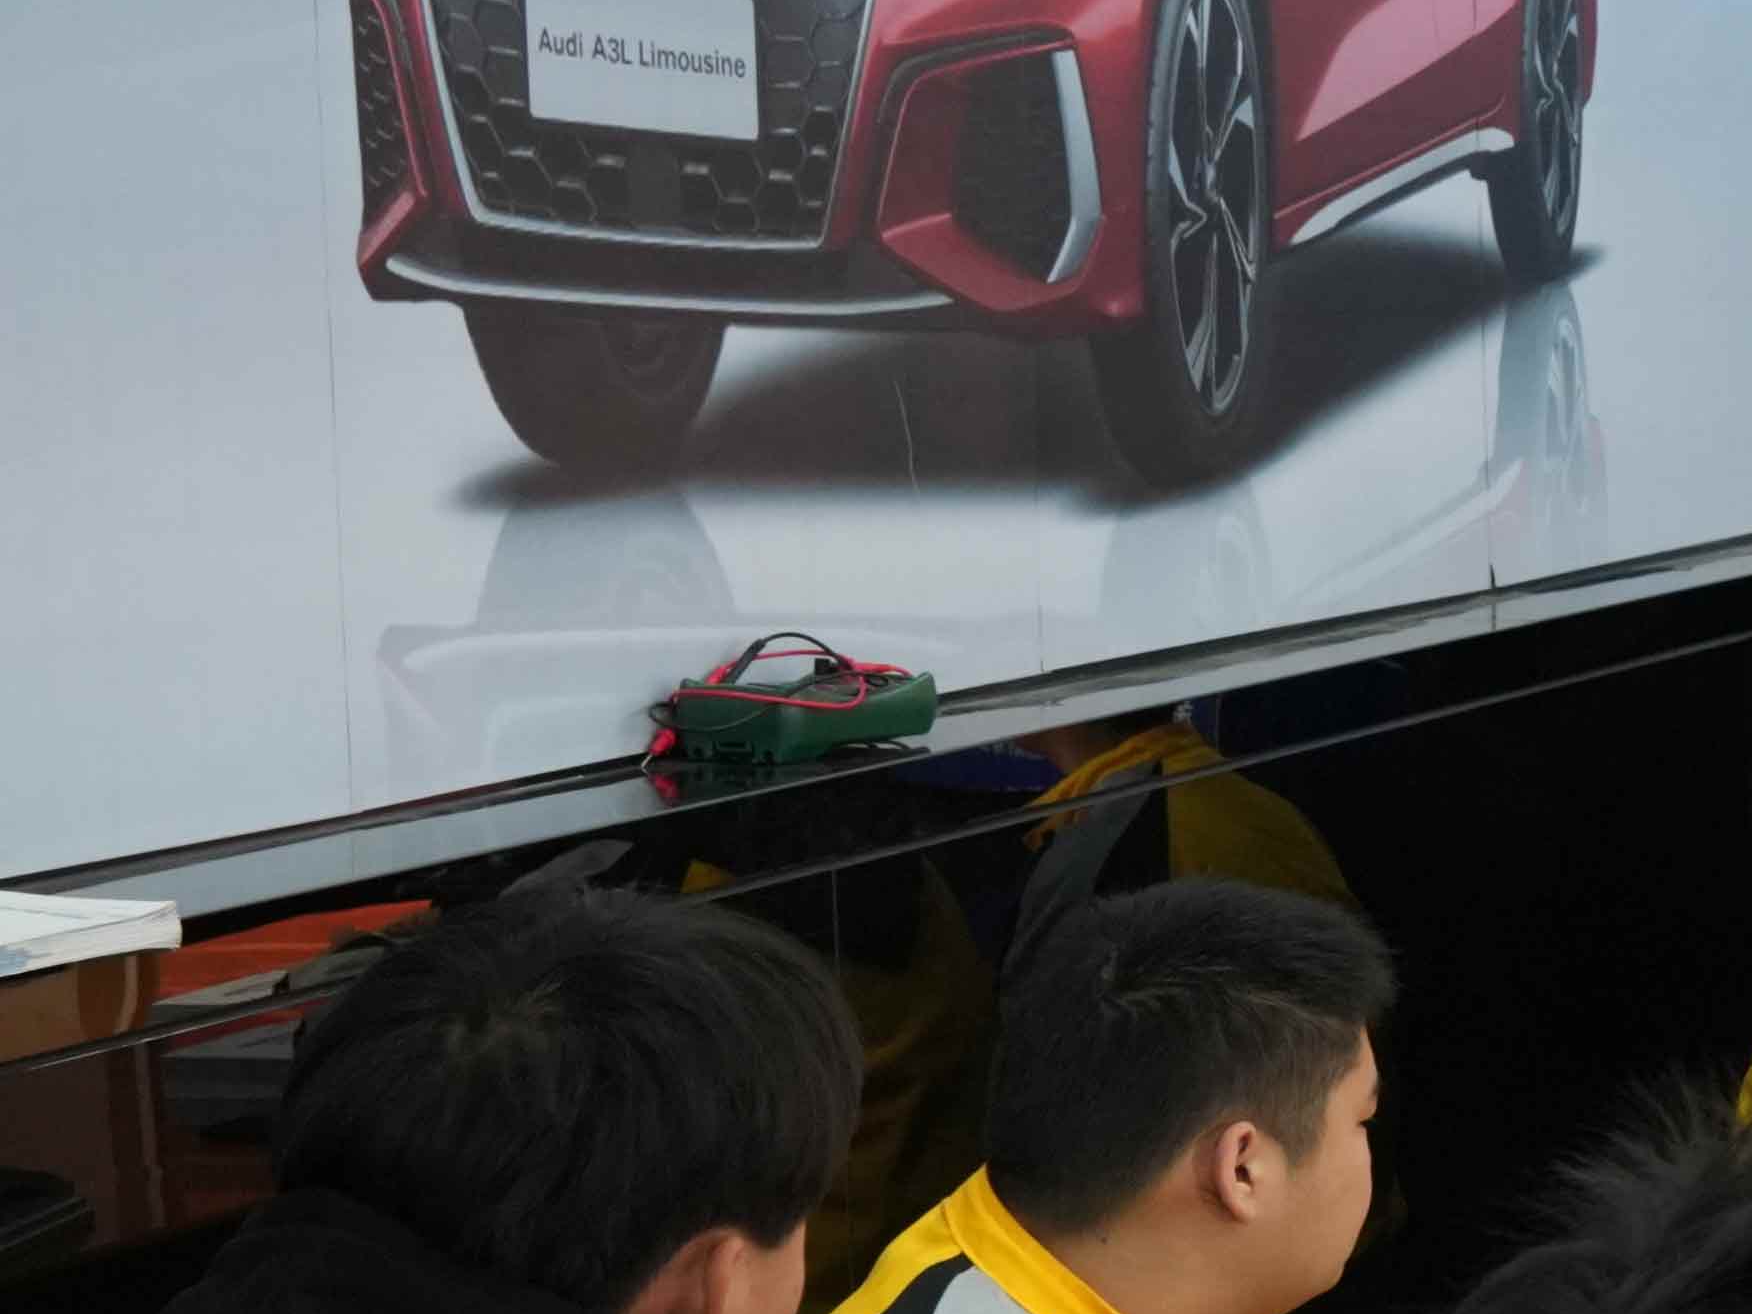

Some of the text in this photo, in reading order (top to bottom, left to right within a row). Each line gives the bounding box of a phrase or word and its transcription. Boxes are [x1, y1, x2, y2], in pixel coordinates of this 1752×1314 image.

[539, 26, 746, 78] Audi A3L Limousine
